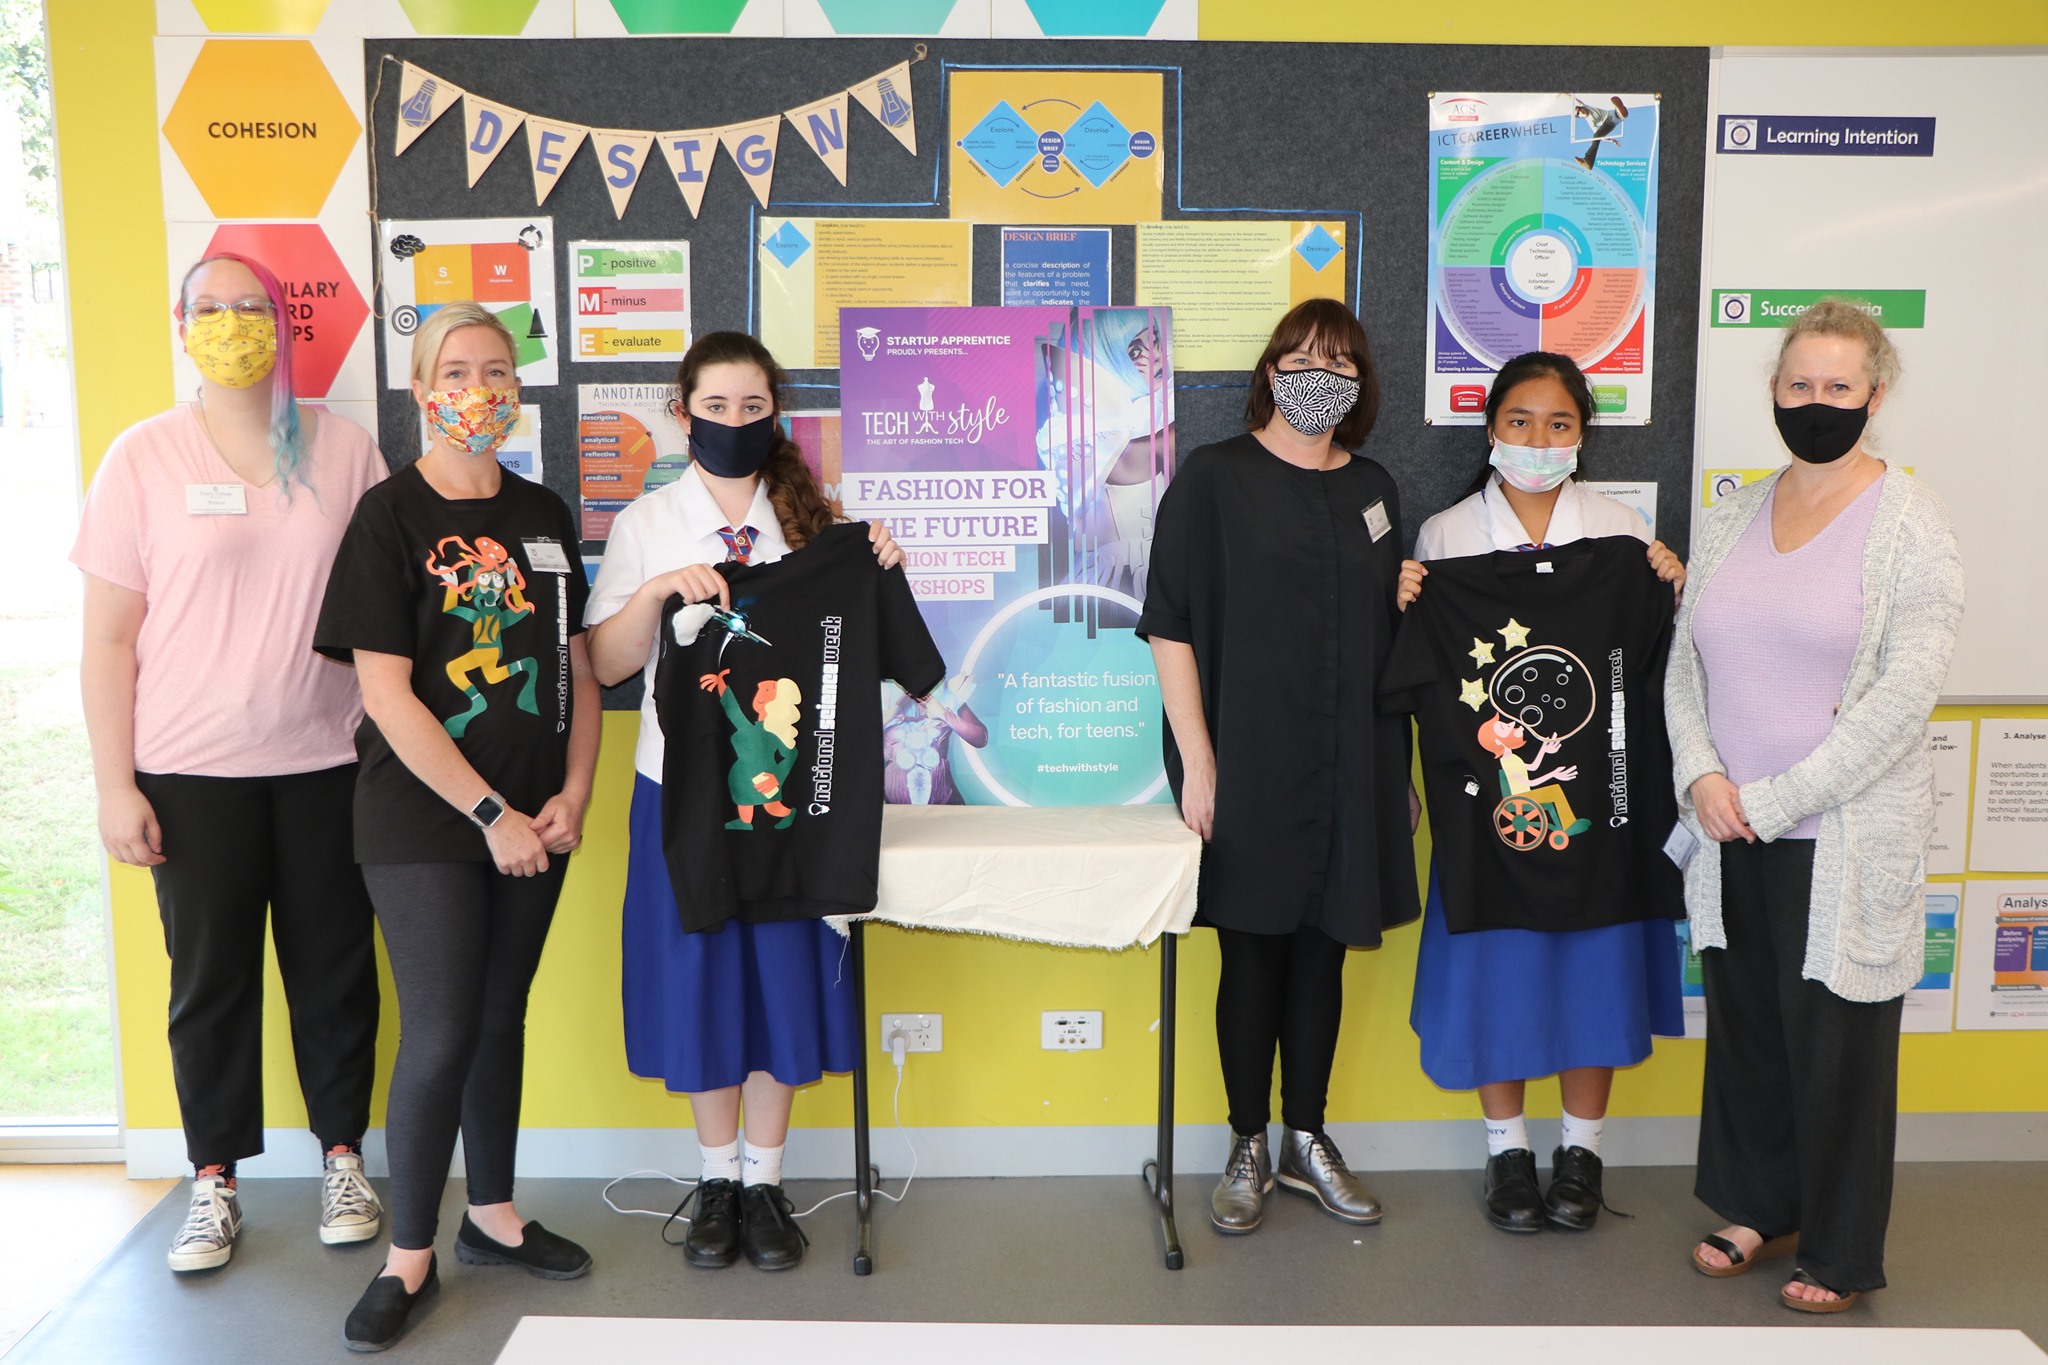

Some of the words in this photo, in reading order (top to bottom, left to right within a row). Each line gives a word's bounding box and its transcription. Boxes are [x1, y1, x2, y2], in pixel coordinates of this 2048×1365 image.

[208, 122, 317, 139] COHESION
[1767, 127, 1839, 147] Learning
[1844, 128, 1919, 145] Intention
[469, 108, 845, 189] DESIGN
[1004, 232, 1044, 241] DESIGN
[1045, 232, 1077, 241] BRIEF
[438, 266, 448, 278] S
[494, 264, 507, 276] W
[579, 255, 594, 274] P
[611, 258, 656, 270] positive
[1042, 261, 1080, 270] description
[1005, 270, 1016, 278] the
[1018, 270, 1045, 278] features
[1047, 270, 1055, 278] of
[1062, 270, 1091, 279] problem
[1071, 280, 1091, 288] need,
[1005, 289, 1021, 297] want
[1032, 289, 1070, 298] opportunity
[1081, 289, 1090, 297] be
[580, 293, 600, 312] M
[611, 296, 647, 306] minus
[287, 304, 314, 320] RD
[293, 325, 314, 342] PS
[887, 336, 939, 346] STARTUP
[941, 335, 1011, 345] APPRENTICE
[581, 334, 596, 353] E
[612, 336, 662, 347] evaluate
[887, 348, 923, 356] PROUDLY
[924, 348, 969, 356] PRESENTS...
[593, 386, 682, 400] ANNOTATIONS
[582, 414, 618, 422] descriptive
[862, 412, 910, 436] TECH
[947, 395, 1010, 444] style
[584, 436, 616, 444] analytical
[585, 474, 618, 482] predictive
[859, 478, 985, 501] FASHION
[991, 478, 1047, 500] FOR
[859, 517, 917, 538] HE
[924, 516, 1038, 538] FUTURE
[952, 551, 1006, 567] TECH
[909, 579, 985, 595] KSHOPS
[821, 616, 842, 663] week
[1608, 648, 1624, 691] week
[557, 645, 568, 719] national
[998, 673, 1018, 689] "A
[1021, 672, 1099, 688] fantastic
[1102, 671, 1156, 687] fusion
[815, 663, 839, 730] science
[1016, 698, 1034, 714] of
[1037, 697, 1101, 713] fashion
[1106, 697, 1138, 712] and
[1607, 690, 1626, 751] science
[1009, 724, 1052, 740] tech,
[1056, 723, 1083, 739] for
[1086, 722, 1145, 738] teens."
[2014, 732, 2047, 740] Analyse
[811, 730, 836, 803] national
[1037, 762, 1119, 773] #techwithstyle
[1608, 750, 1628, 815] national
[1990, 779, 2008, 787] They
[2005, 789, 2043, 797] secondary
